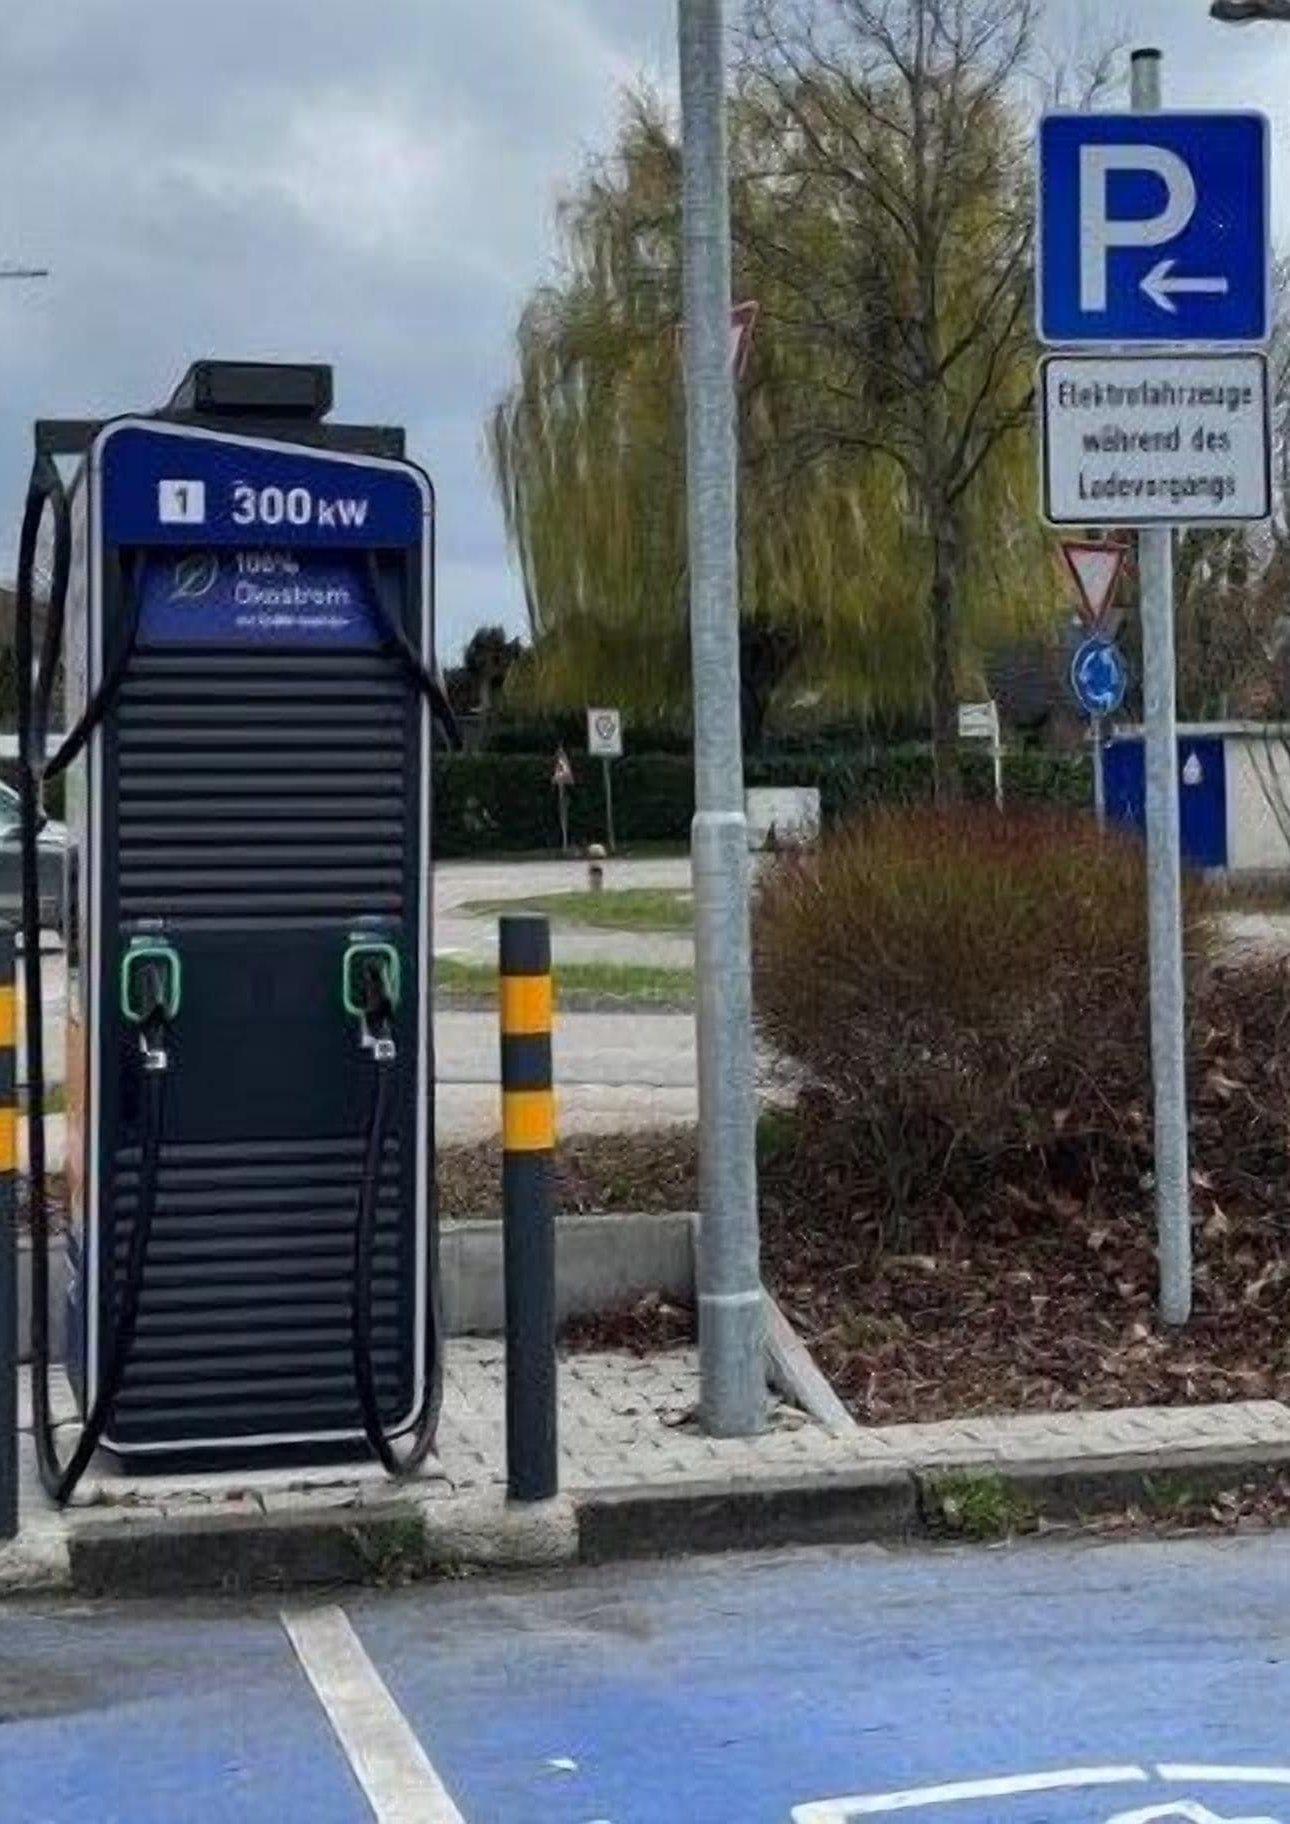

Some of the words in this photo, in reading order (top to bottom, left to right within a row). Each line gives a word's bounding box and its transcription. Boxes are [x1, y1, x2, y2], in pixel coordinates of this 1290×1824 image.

[1079, 143, 1197, 312] P
[1057, 380, 1253, 411] Elektrofahrzeuge
[1081, 424, 1181, 453] während
[1191, 425, 1231, 453] des
[1078, 473, 1237, 505] Ladevorgangs
[231, 486, 312, 526] 300
[317, 498, 369, 528] kW
